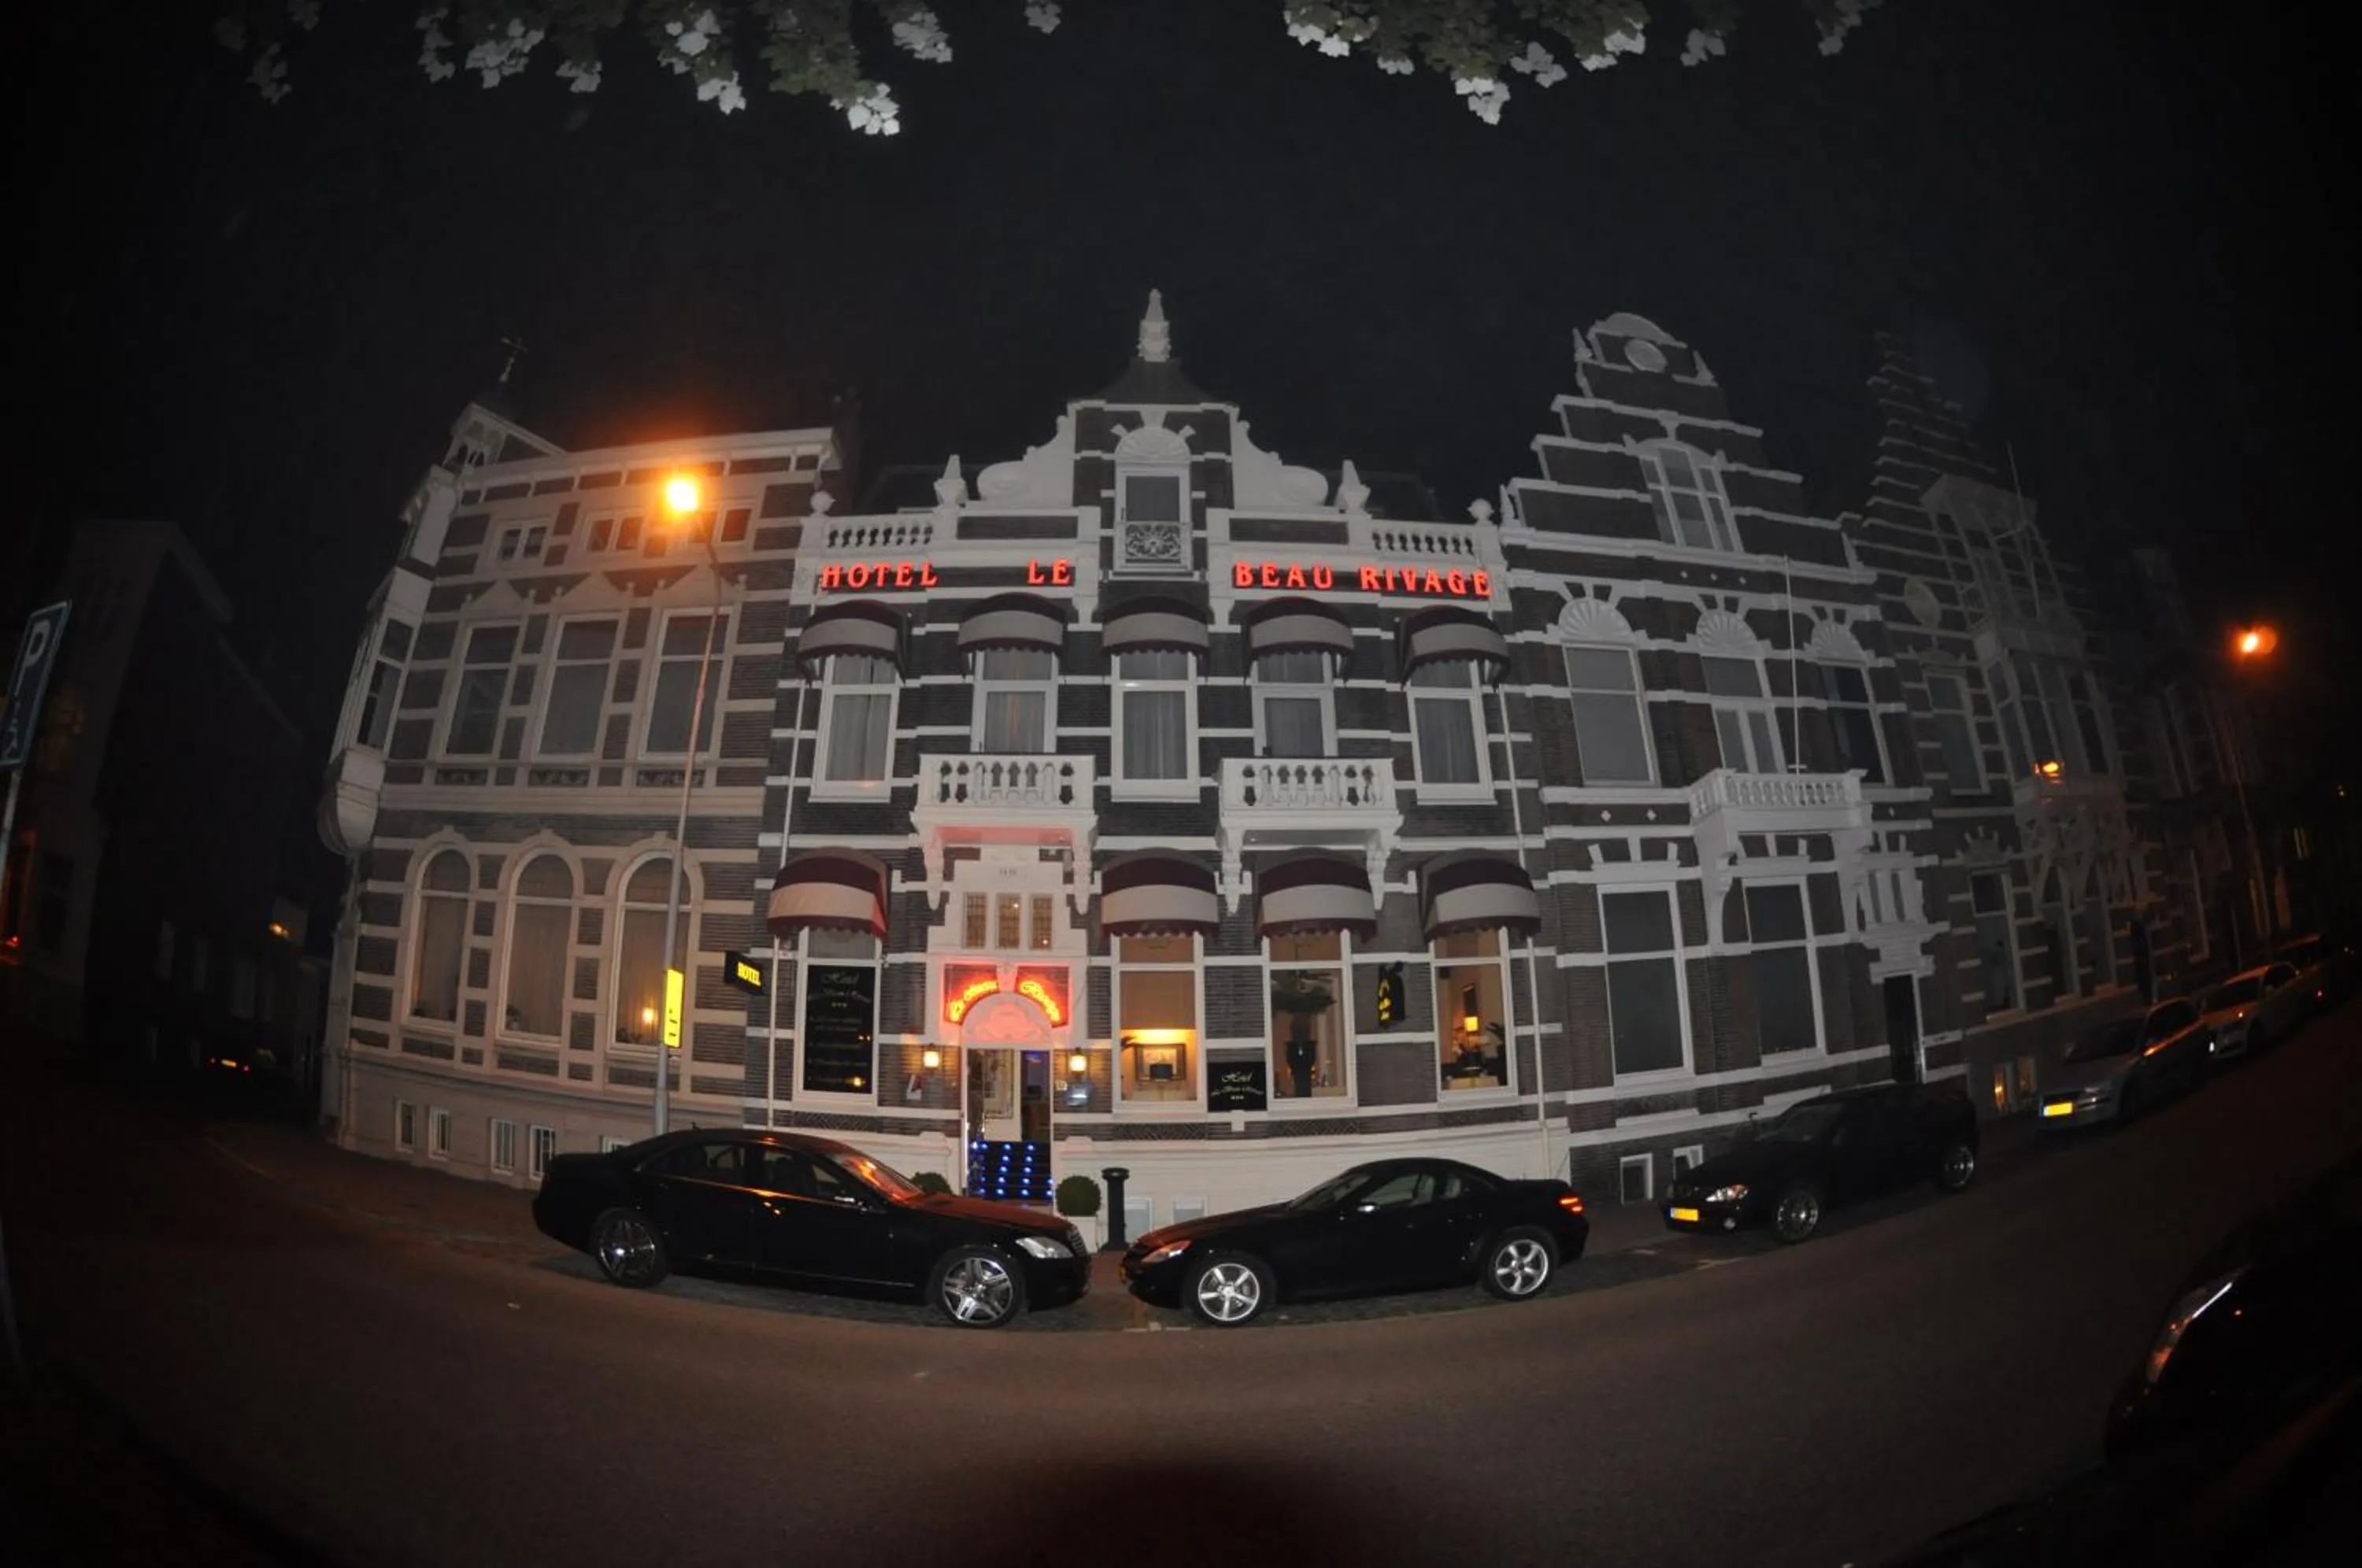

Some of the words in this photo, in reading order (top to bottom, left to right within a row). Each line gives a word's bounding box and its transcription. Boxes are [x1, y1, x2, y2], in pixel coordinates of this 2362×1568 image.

[820, 561, 938, 589] HOTEL
[1027, 558, 1071, 585] LE
[1235, 560, 1335, 590] BEAU
[1358, 565, 1492, 597] RIVAGE
[14, 619, 51, 697] P
[738, 961, 761, 986] HOTEL
